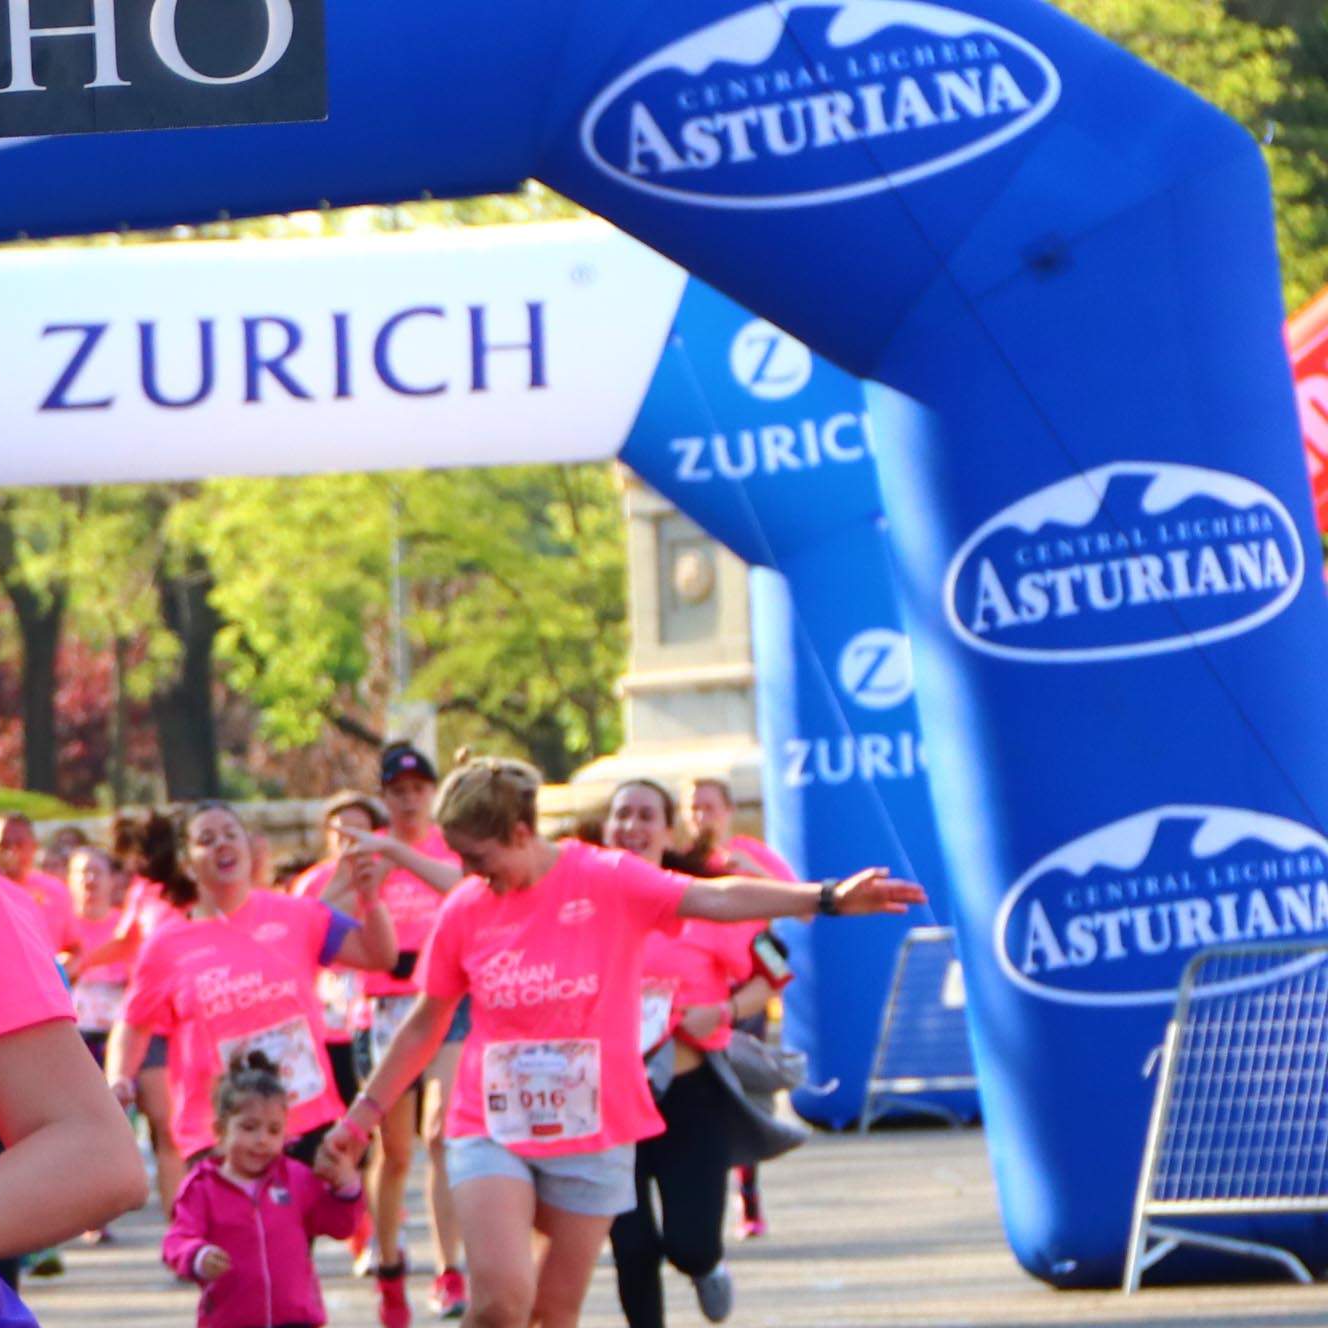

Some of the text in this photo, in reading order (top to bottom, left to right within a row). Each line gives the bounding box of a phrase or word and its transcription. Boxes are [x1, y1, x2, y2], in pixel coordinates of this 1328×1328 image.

[678, 37, 1001, 110] CENTRAL LECHERA
[627, 62, 1032, 175] ASTURIANA
[38, 301, 548, 411] ZURICH
[1015, 511, 1274, 566] CENTRAL LECHERA
[971, 538, 1290, 634] ASTURIANA
[1065, 853, 1325, 908] CENTRAL LECHERA
[521, 1088, 564, 1108] 016
